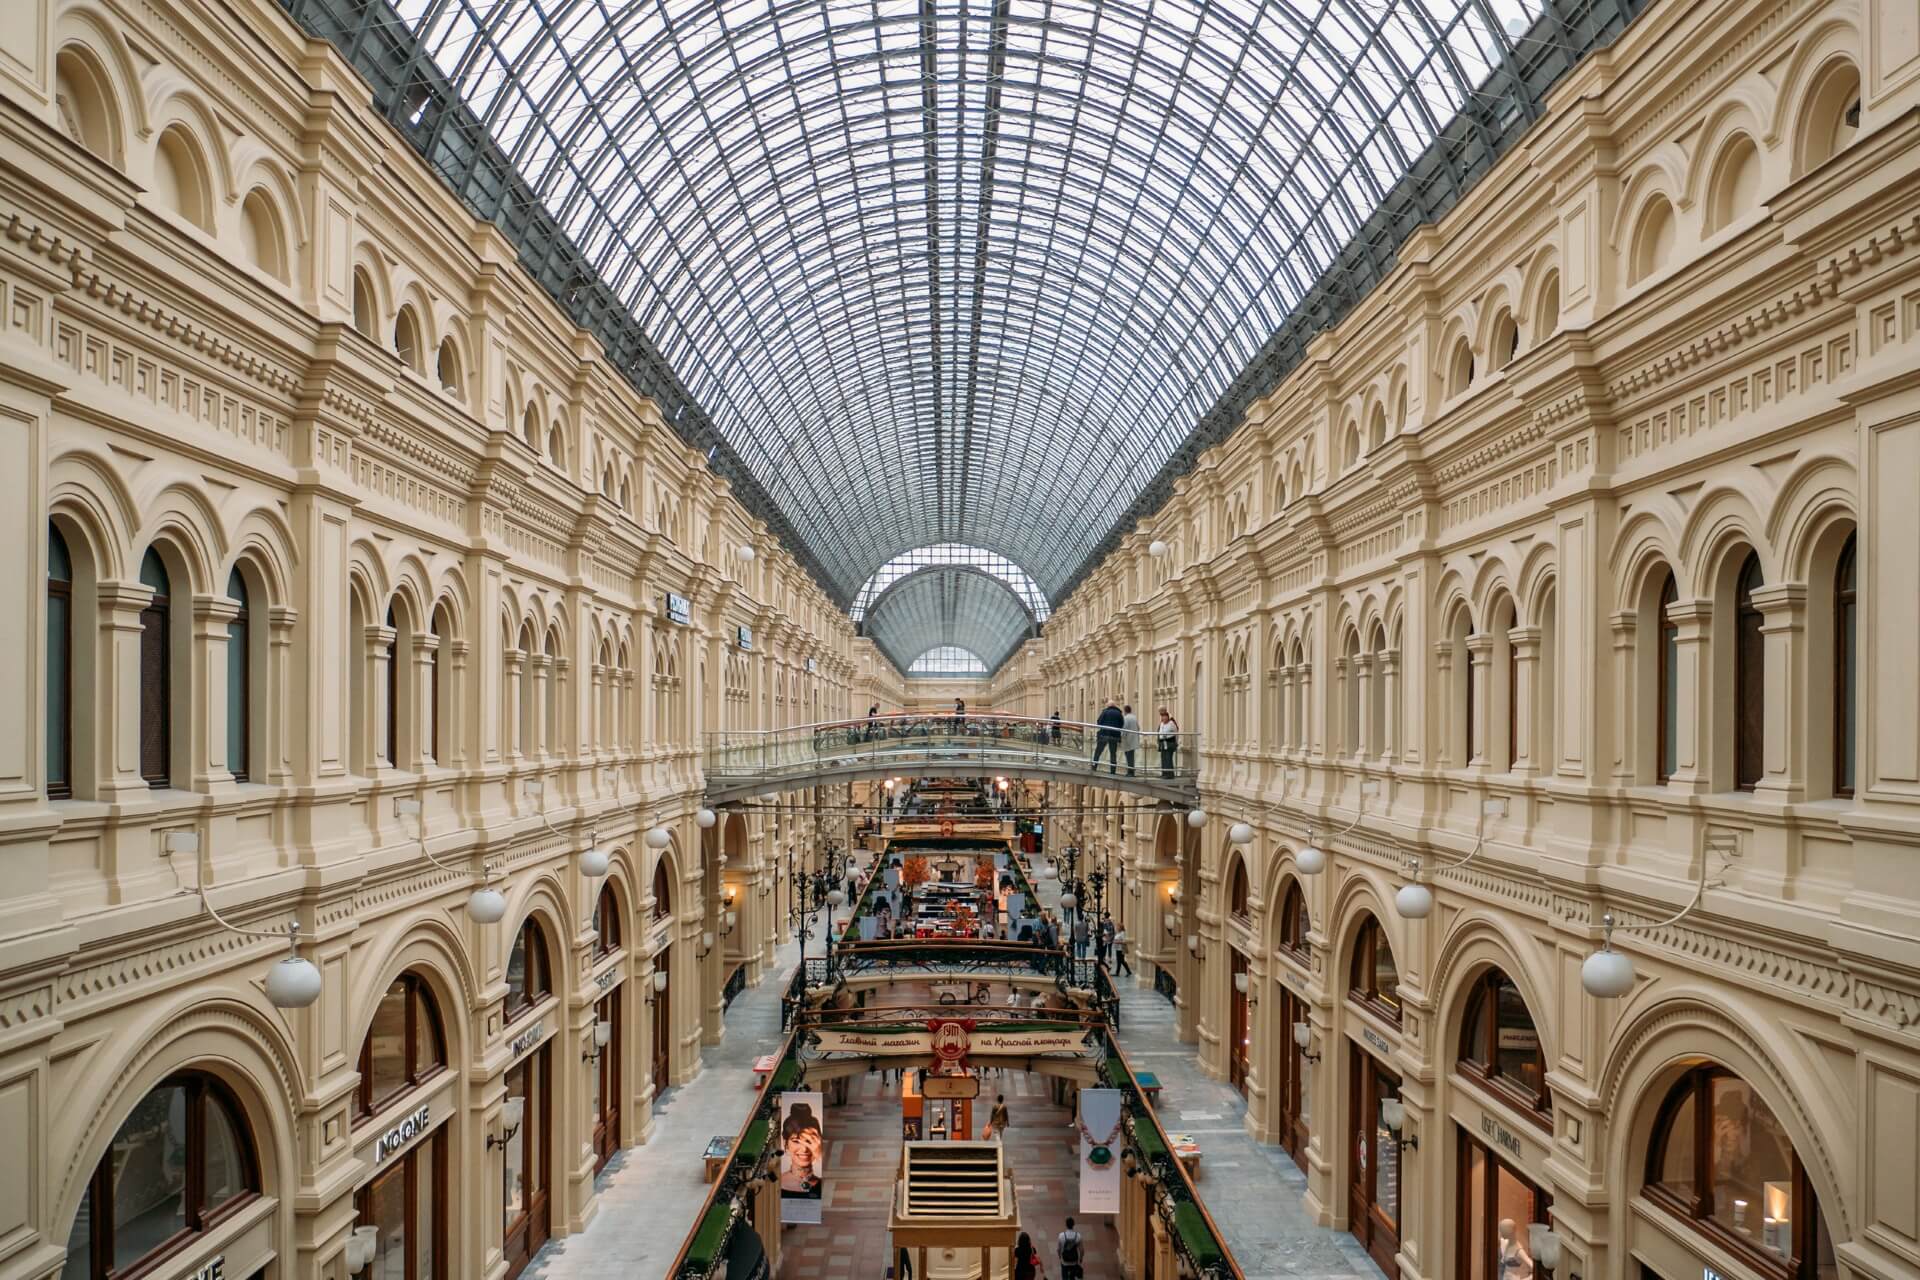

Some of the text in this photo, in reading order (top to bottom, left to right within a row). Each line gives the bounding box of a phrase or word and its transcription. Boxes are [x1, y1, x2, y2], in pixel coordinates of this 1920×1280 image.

[840, 1034, 921, 1047] Главный магазин
[995, 1036, 1032, 1048] Красной
[1034, 1038, 1071, 1047] площади
